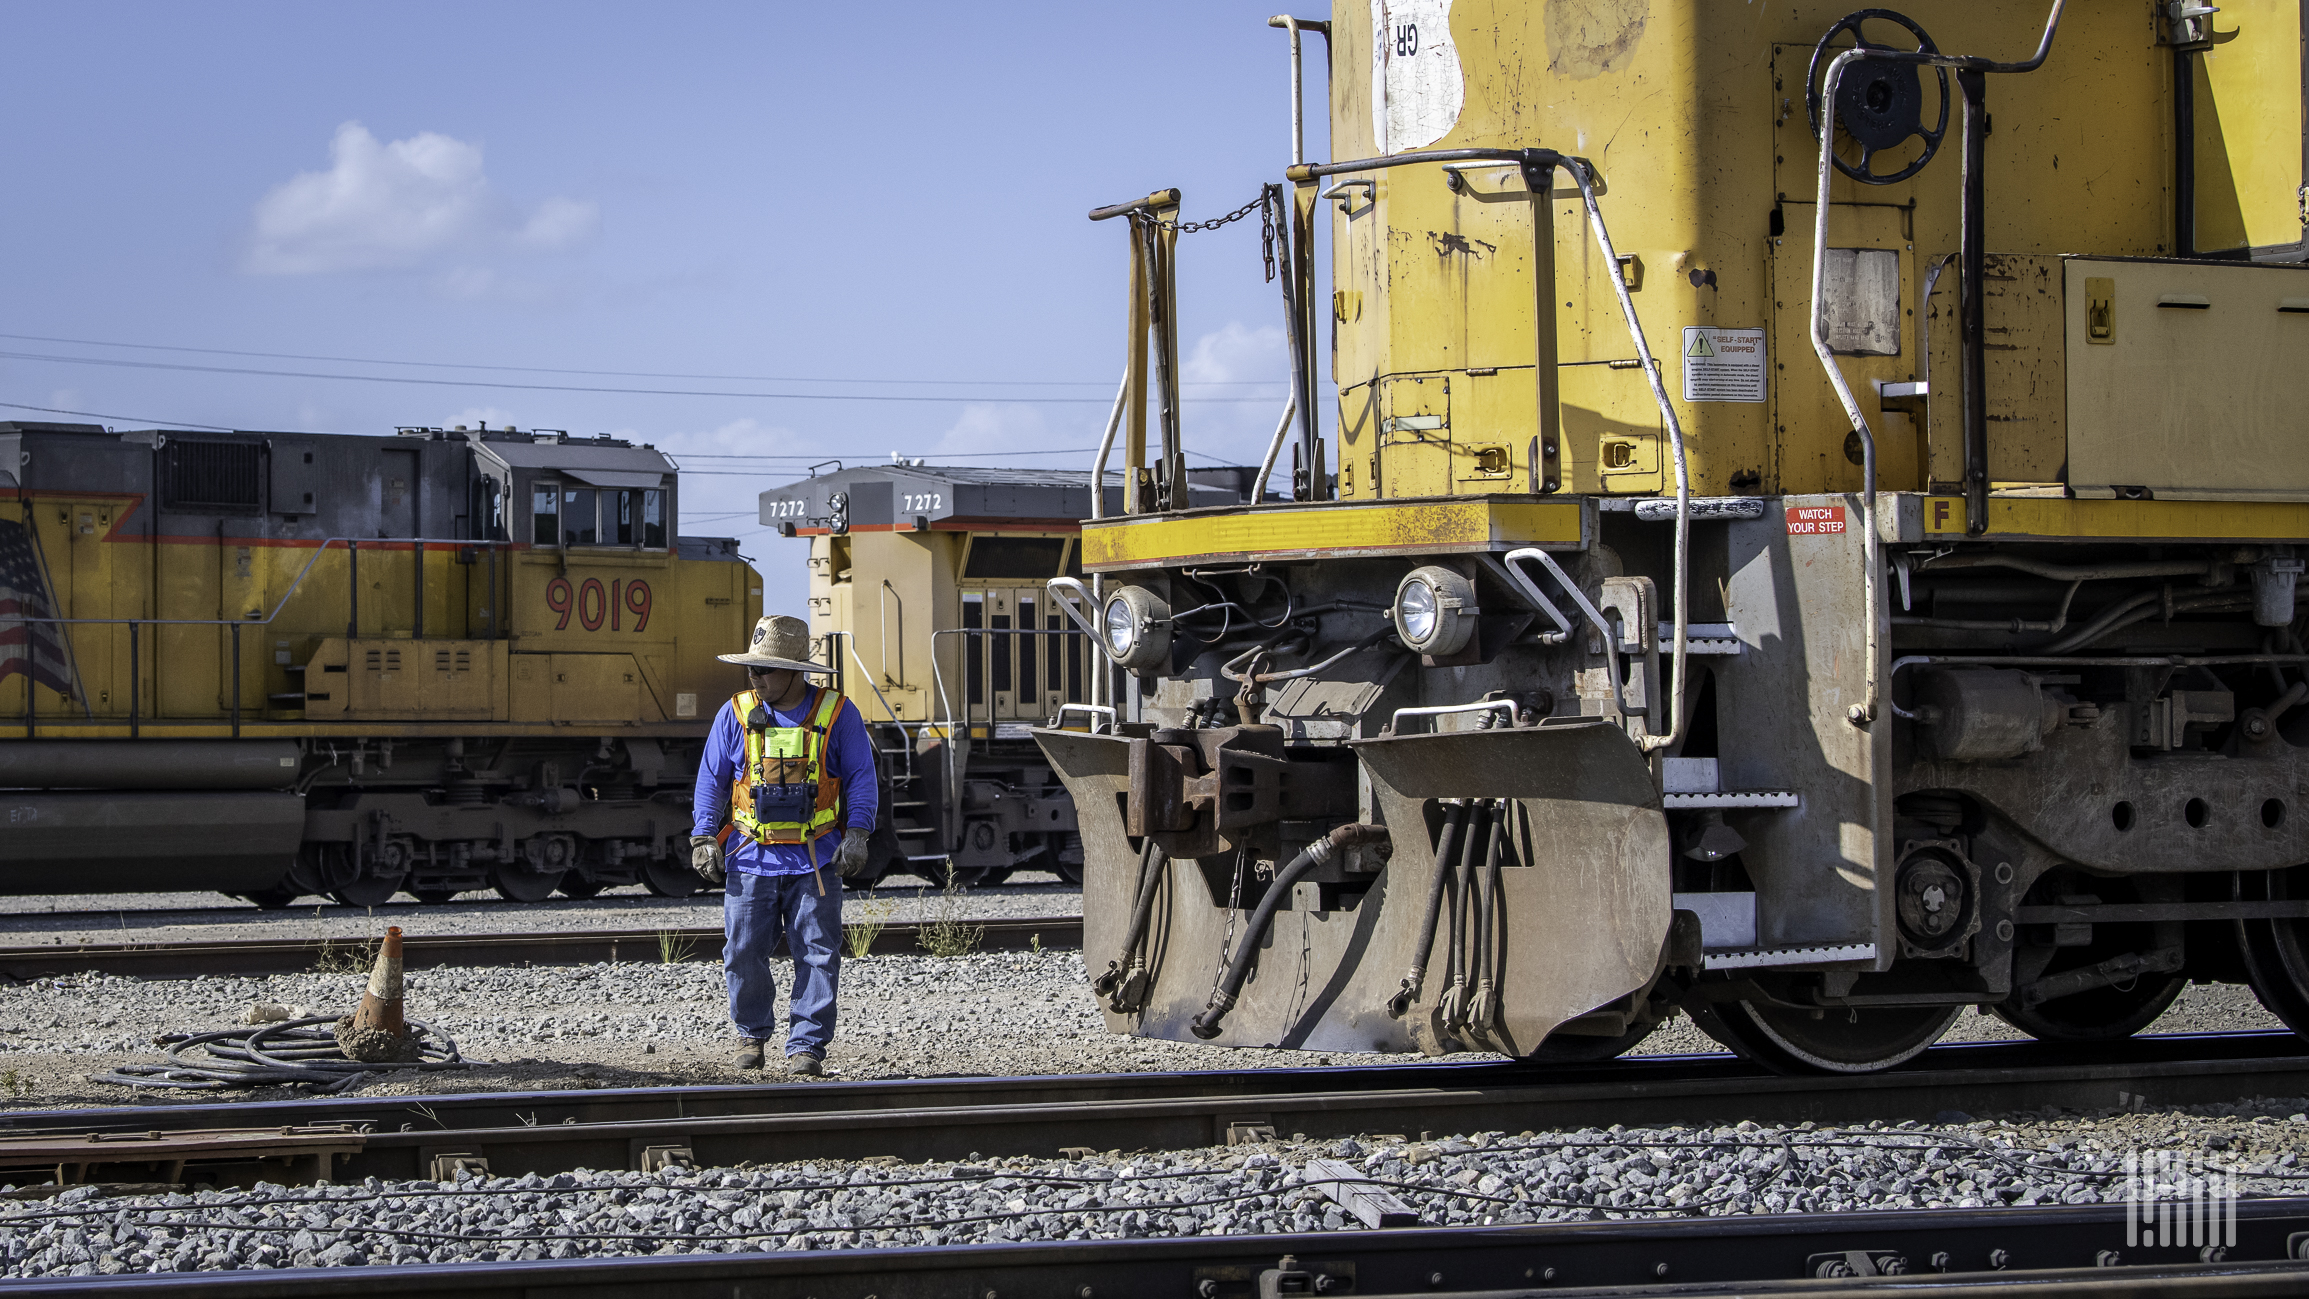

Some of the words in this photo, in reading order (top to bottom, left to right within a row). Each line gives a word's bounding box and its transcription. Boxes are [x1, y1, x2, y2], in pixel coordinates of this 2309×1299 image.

[1397, 23, 1418, 57] GR
[770, 500, 804, 518] 7272
[905, 494, 942, 511] 7272
[1799, 509, 1832, 520] WATCH
[1934, 501, 1949, 529] F
[1788, 522, 1815, 533] YOUR
[1818, 521, 1844, 532] STEP
[546, 577, 652, 632] 9019
